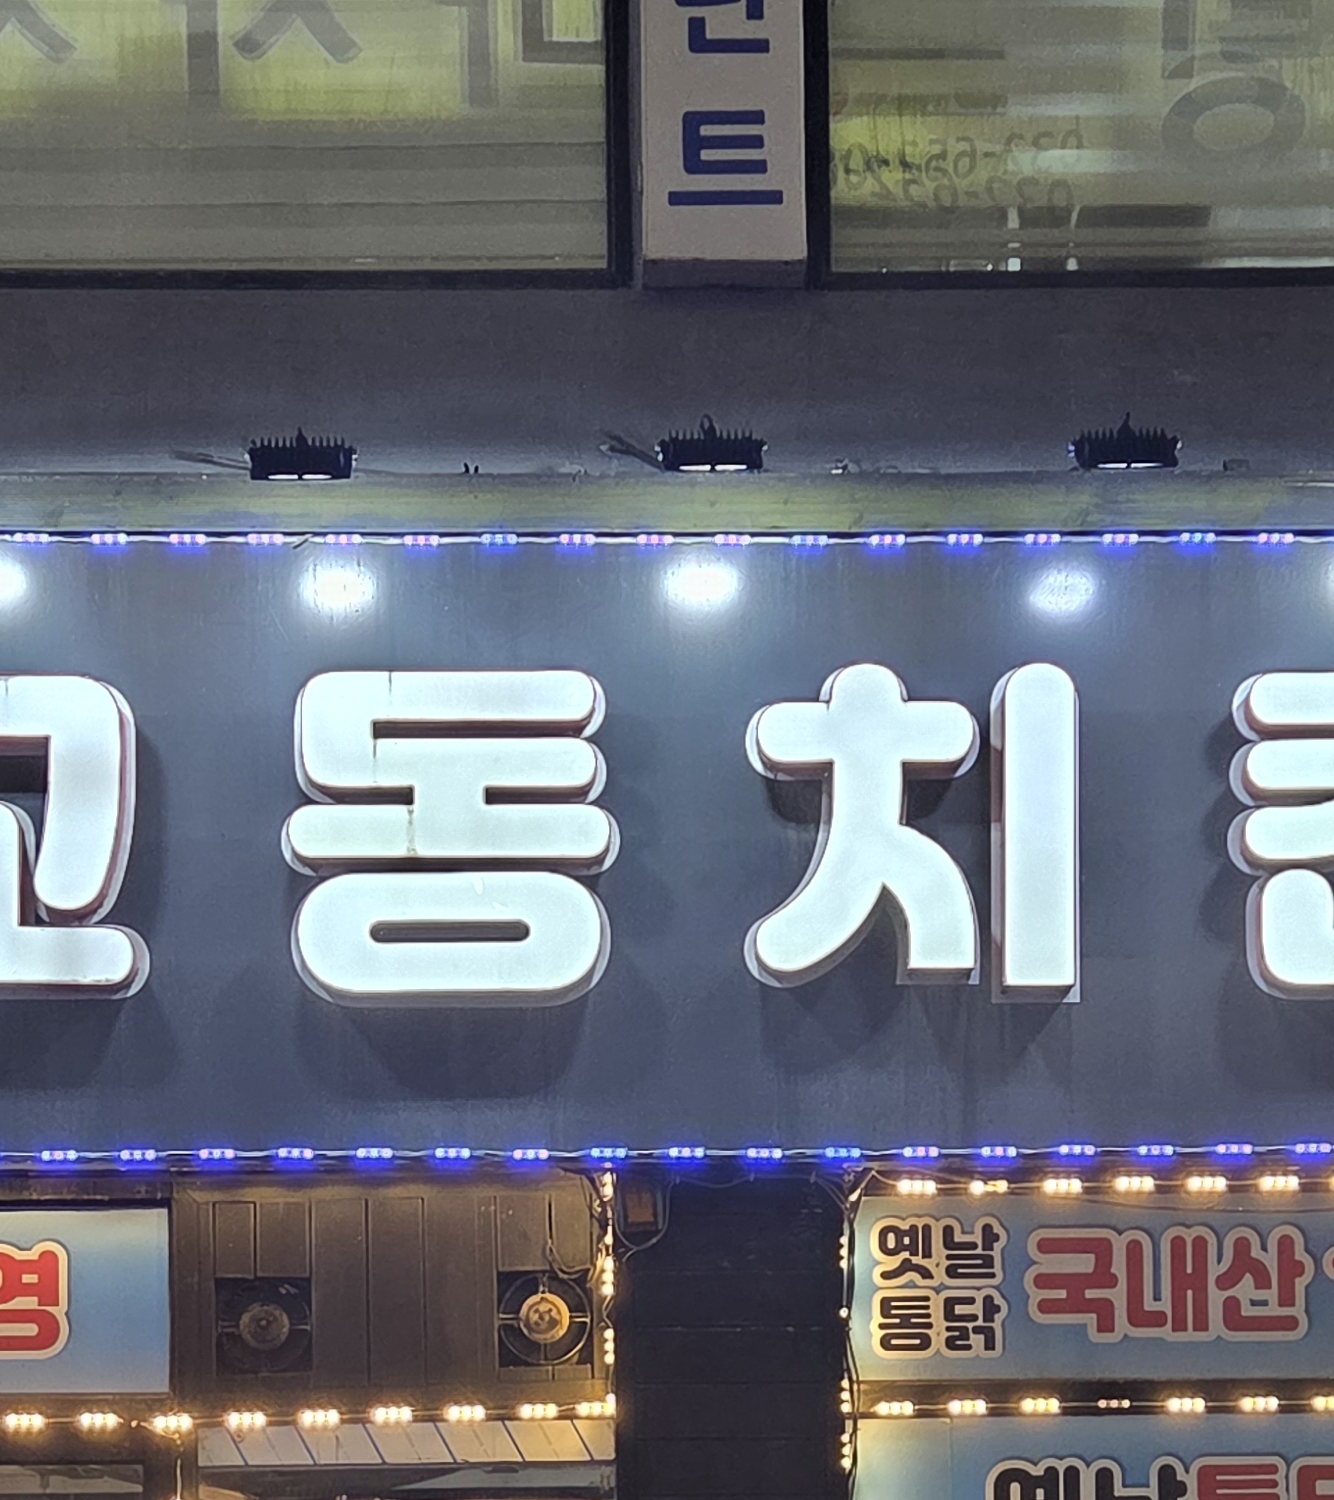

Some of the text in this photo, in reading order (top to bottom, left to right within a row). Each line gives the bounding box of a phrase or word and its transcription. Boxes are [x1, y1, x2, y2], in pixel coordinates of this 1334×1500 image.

[869, 1215, 1008, 1288] 옛날
[1024, 1223, 1315, 1344] 국내산
[870, 1286, 1008, 1359] 통닭
